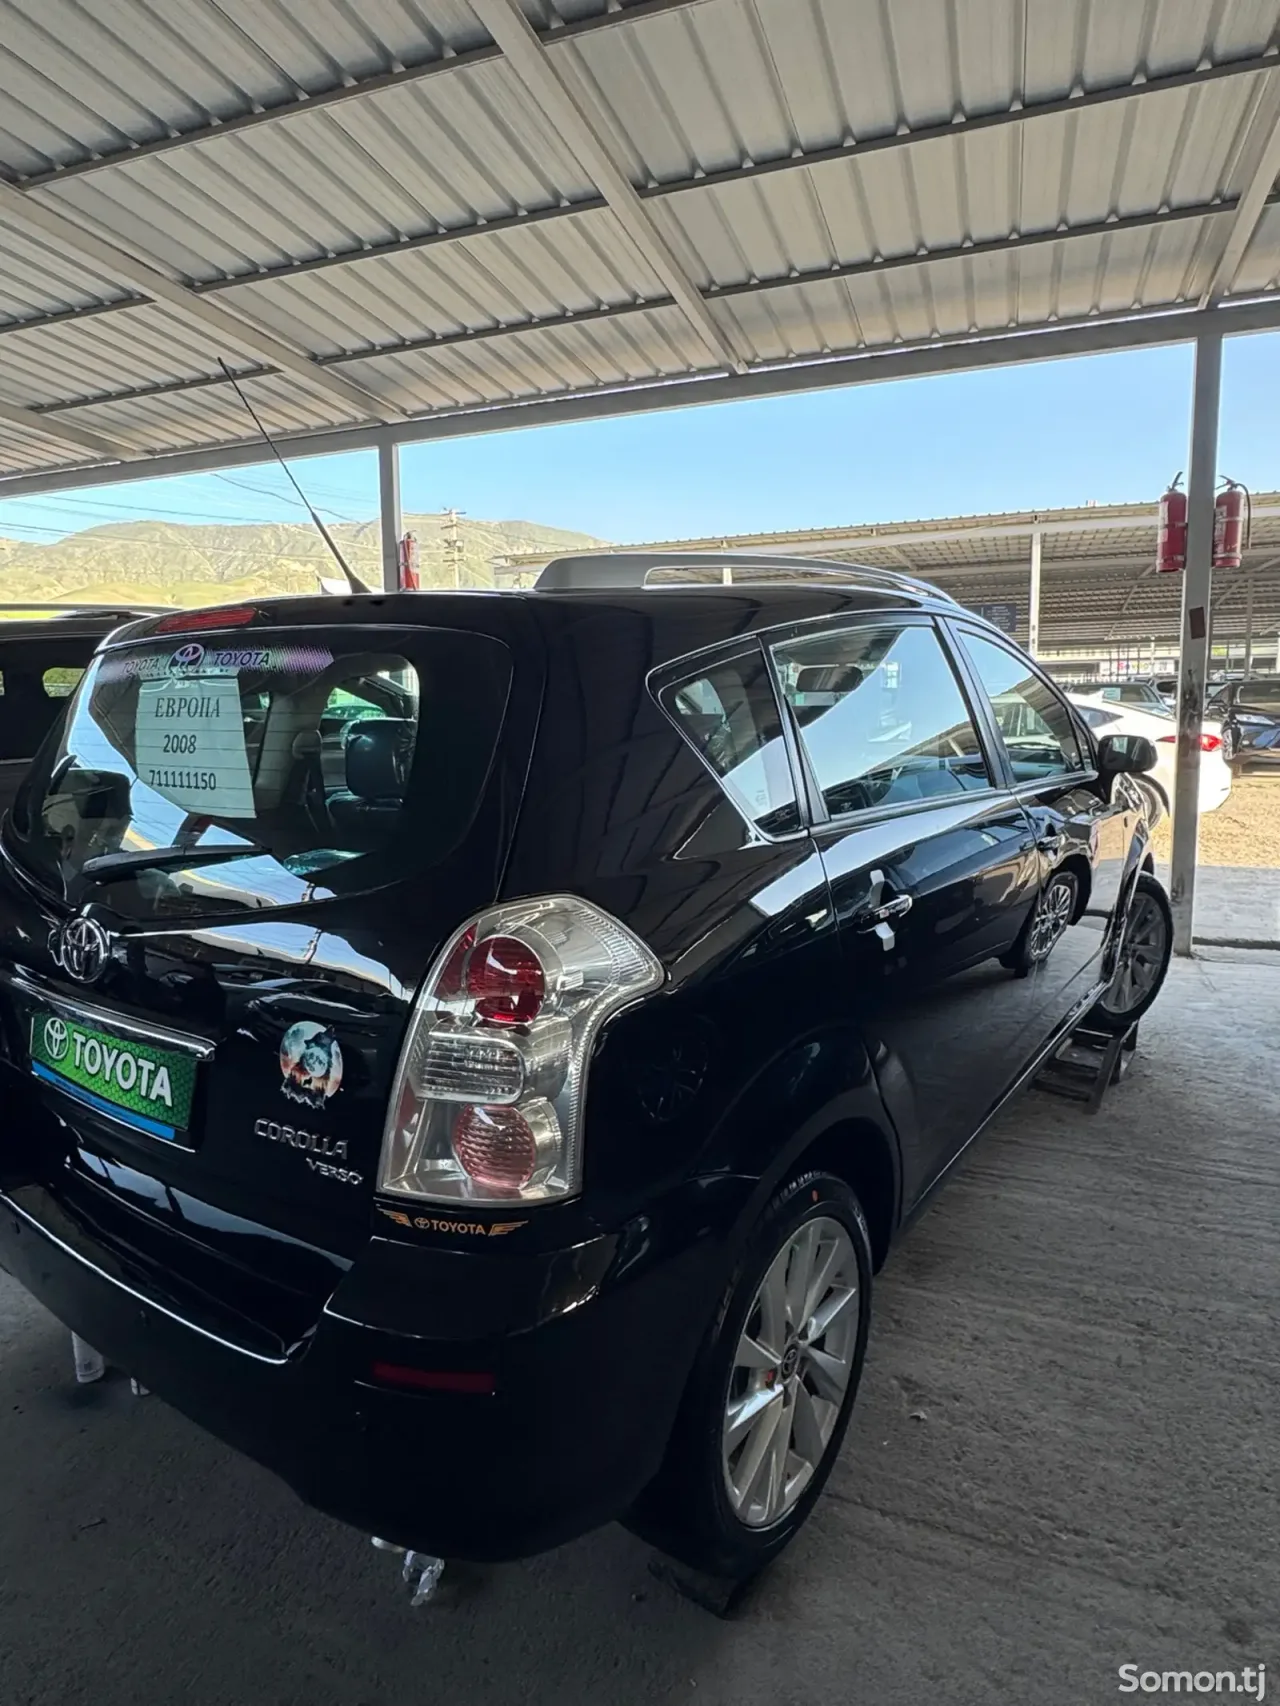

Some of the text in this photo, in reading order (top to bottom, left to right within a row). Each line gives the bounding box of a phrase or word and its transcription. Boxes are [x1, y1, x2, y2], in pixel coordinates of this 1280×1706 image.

[123, 651, 270, 674] TOYOTA TOYOTA
[155, 697, 221, 718] ЕВРОПА
[163, 734, 198, 755] 2008
[149, 769, 217, 791] 711111150
[72, 1031, 173, 1108] TOYOTA
[254, 1118, 349, 1160] COROLLA
[305, 1157, 364, 1186] VERSO
[431, 1219, 486, 1236] TOYOTA
